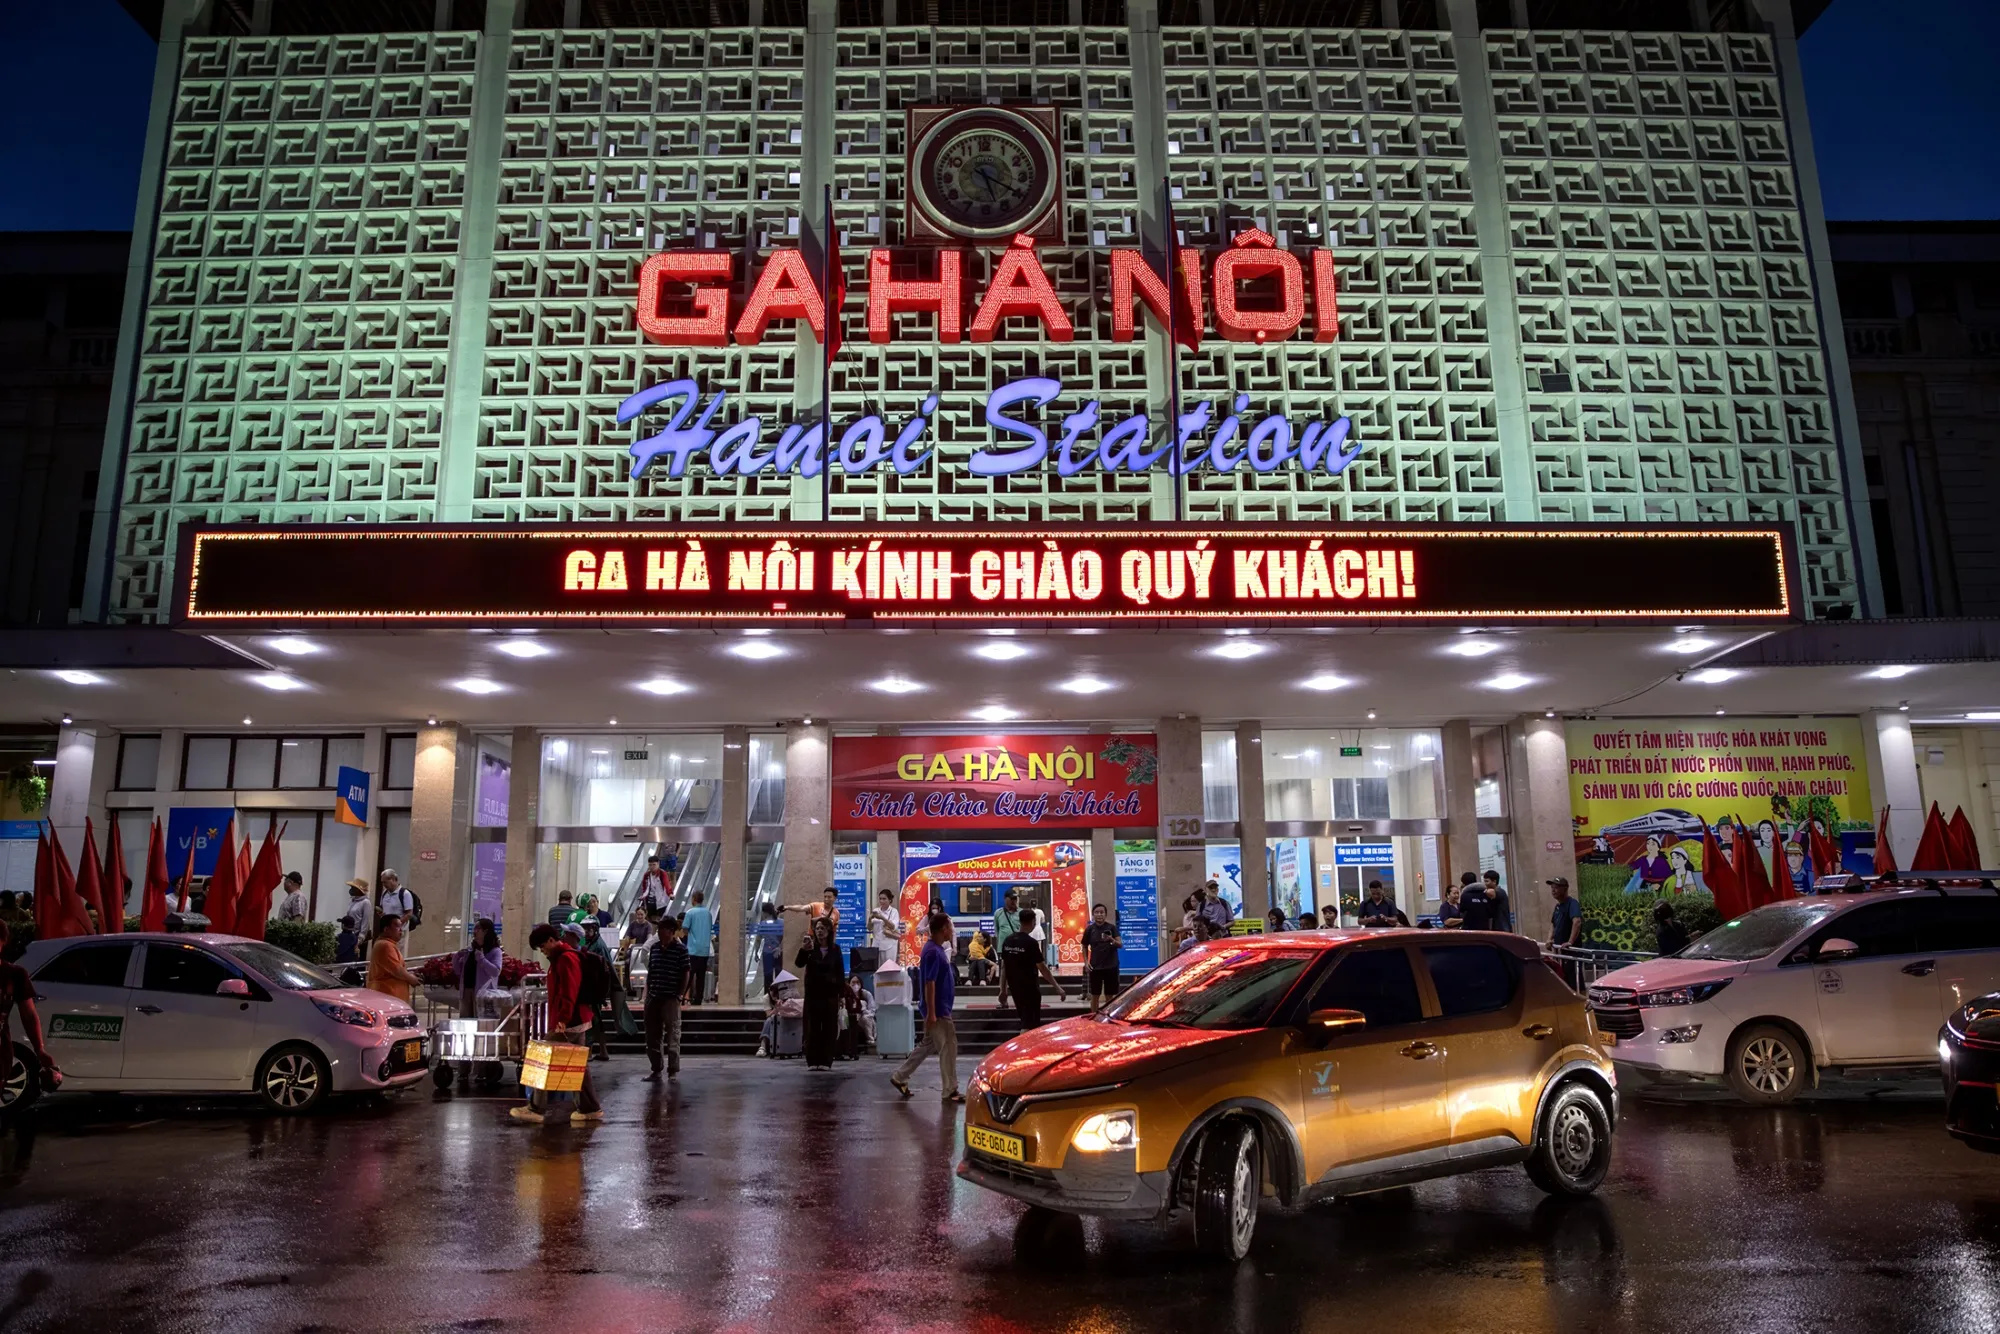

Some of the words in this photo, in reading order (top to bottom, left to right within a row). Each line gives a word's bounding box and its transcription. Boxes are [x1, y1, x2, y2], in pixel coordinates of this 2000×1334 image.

[637, 249, 826, 346] GA
[869, 233, 1074, 344] HÀ
[1110, 227, 1339, 344] NỘI
[617, 378, 940, 480] Hanoi
[967, 376, 1363, 478] Station
[564, 550, 628, 590] GA
[646, 540, 710, 590] HÀ
[831, 540, 952, 600] KÍNH
[969, 540, 1103, 601] CHÀO
[1120, 540, 1217, 604] QUÝ
[1233, 540, 1417, 599] KHÁCH!
[1593, 729, 1631, 750] QUYẾT
[1635, 730, 1661, 748] TÂM
[1665, 730, 1694, 751] HIỆN
[1697, 731, 1728, 751] THỰC
[1732, 729, 1757, 747] HÓA
[1760, 728, 1790, 747] KHÁT
[1793, 731, 1827, 750] VỌNG
[626, 752, 646, 760] EXIT
[897, 753, 955, 781] GA
[964, 745, 1020, 781] HÀ
[1028, 745, 1094, 786] NỘI
[1570, 756, 1601, 774] PHÁT
[1605, 752, 1642, 774] TRIỂN
[1645, 753, 1668, 774] ĐẤT
[1672, 755, 1706, 773] NƯỚC
[1709, 752, 1743, 772] PHỒN
[1745, 756, 1779, 773] VINH,
[1782, 755, 1815, 775] HẠNH
[1818, 752, 1855, 772] PHÚC,
[348, 785, 366, 803] ATM
[1583, 781, 1618, 799] SÁNH
[1620, 784, 1640, 799] VAI
[1643, 780, 1664, 798] VỚI
[1667, 780, 1692, 798] CÁC
[1696, 778, 1738, 798] CƯỜNG
[1741, 776, 1774, 798] QUỐC
[1778, 778, 1807, 796] NĂM
[850, 791, 917, 818] Kính
[923, 791, 988, 818] Chào
[993, 791, 1049, 824] Quý
[1055, 790, 1142, 817] Khách
[1168, 818, 1201, 836] 120
[178, 836, 207, 850] VB
[958, 860, 989, 869] ĐƯỜNG
[992, 857, 1007, 869] SẮT
[1009, 858, 1025, 869] VIỆT
[1026, 860, 1047, 868] NAM
[92, 1022, 120, 1032] TAXI
[971, 1130, 1018, 1156] 29E-060.48
